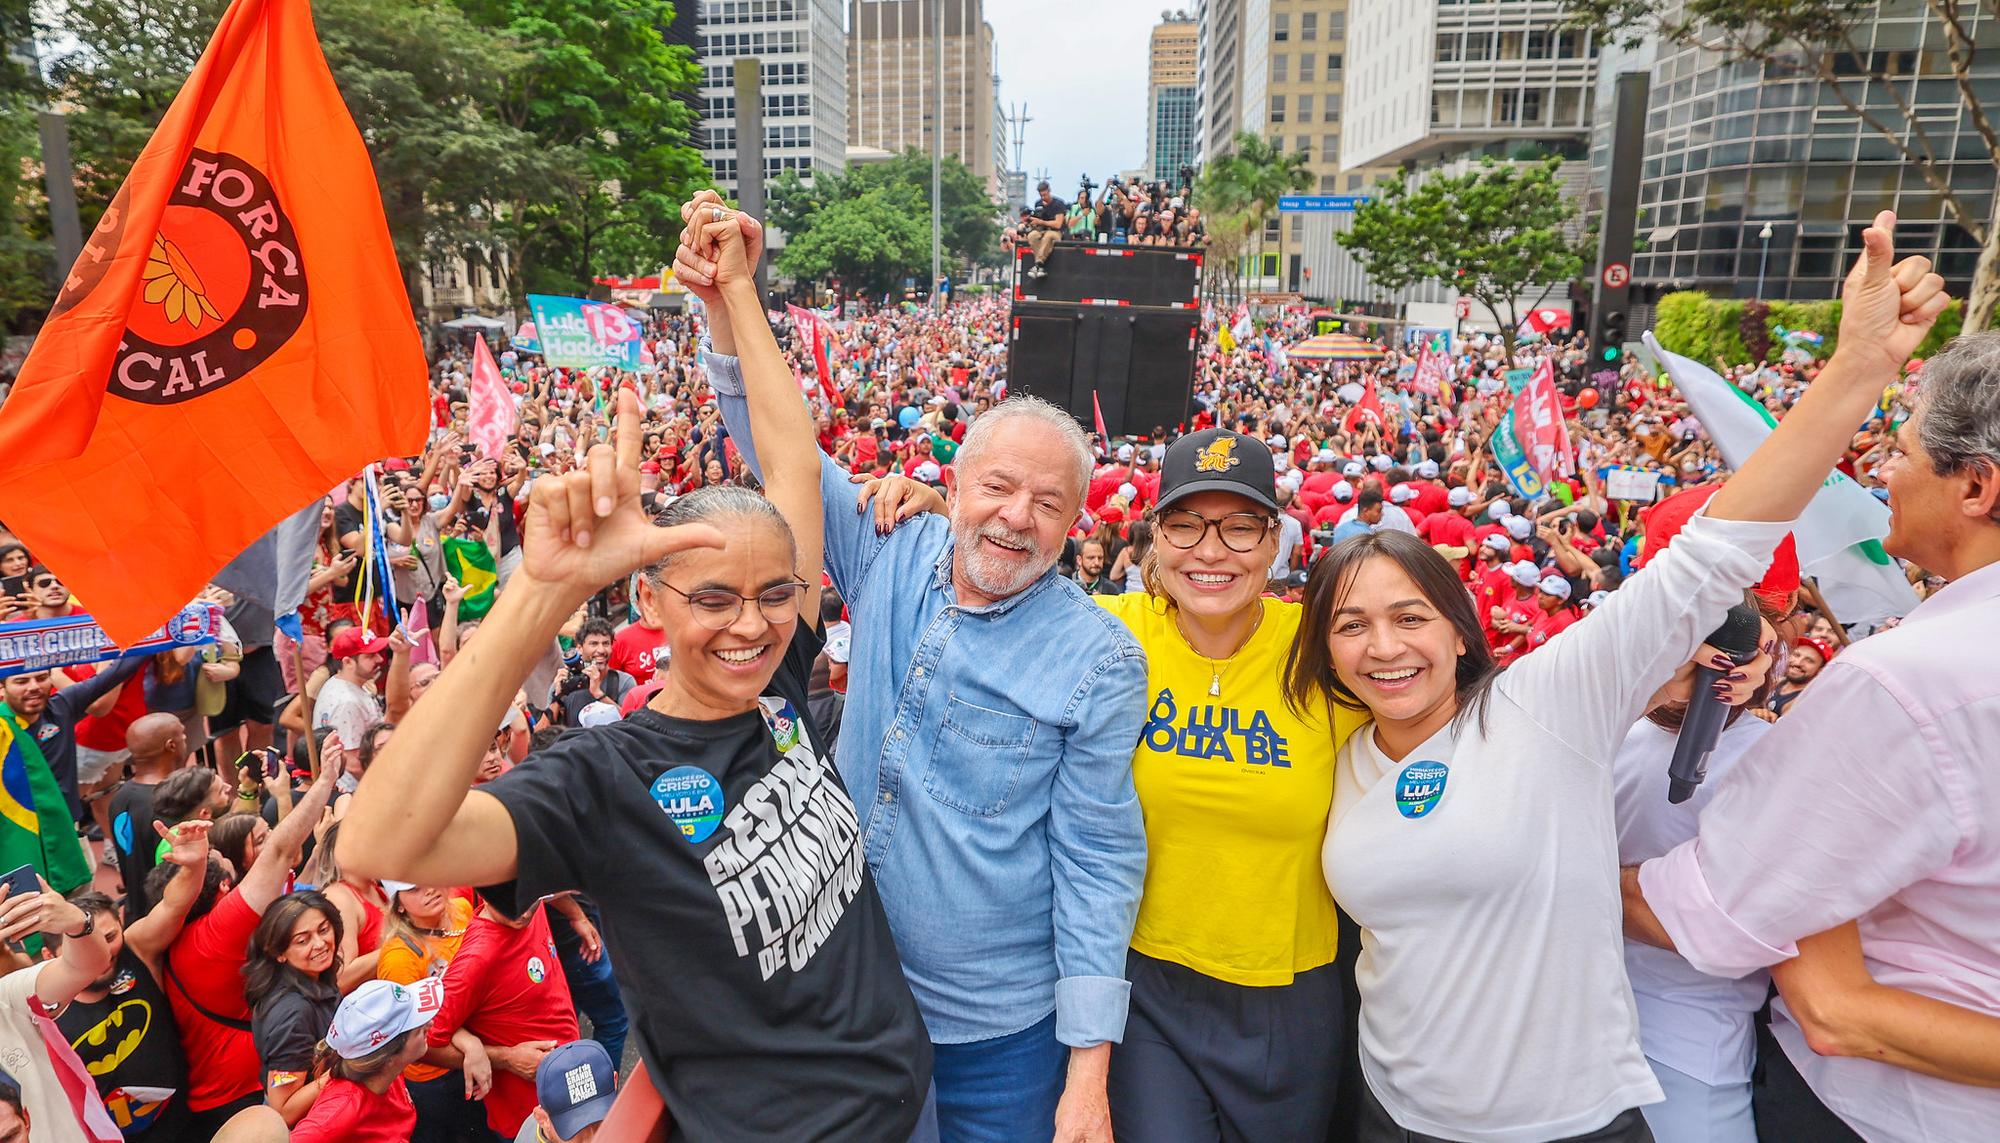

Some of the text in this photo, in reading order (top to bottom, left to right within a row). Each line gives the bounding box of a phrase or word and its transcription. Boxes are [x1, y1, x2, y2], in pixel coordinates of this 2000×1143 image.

[181, 158, 301, 310] FORÇA
[586, 305, 632, 342] 13
[543, 333, 630, 362] Haddad
[116, 341, 225, 397] CAL
[1511, 461, 1543, 496] 13
[43, 626, 105, 654] CLUBE
[1150, 688, 1279, 737] Ô LULA
[657, 778, 711, 793] CRISTO
[1404, 781, 1441, 797] LULA
[1406, 770, 1447, 780] CRISTO
[657, 795, 715, 814] LULA
[681, 824, 696, 836] 13
[703, 837, 749, 886] EM
[758, 937, 786, 982] DE
